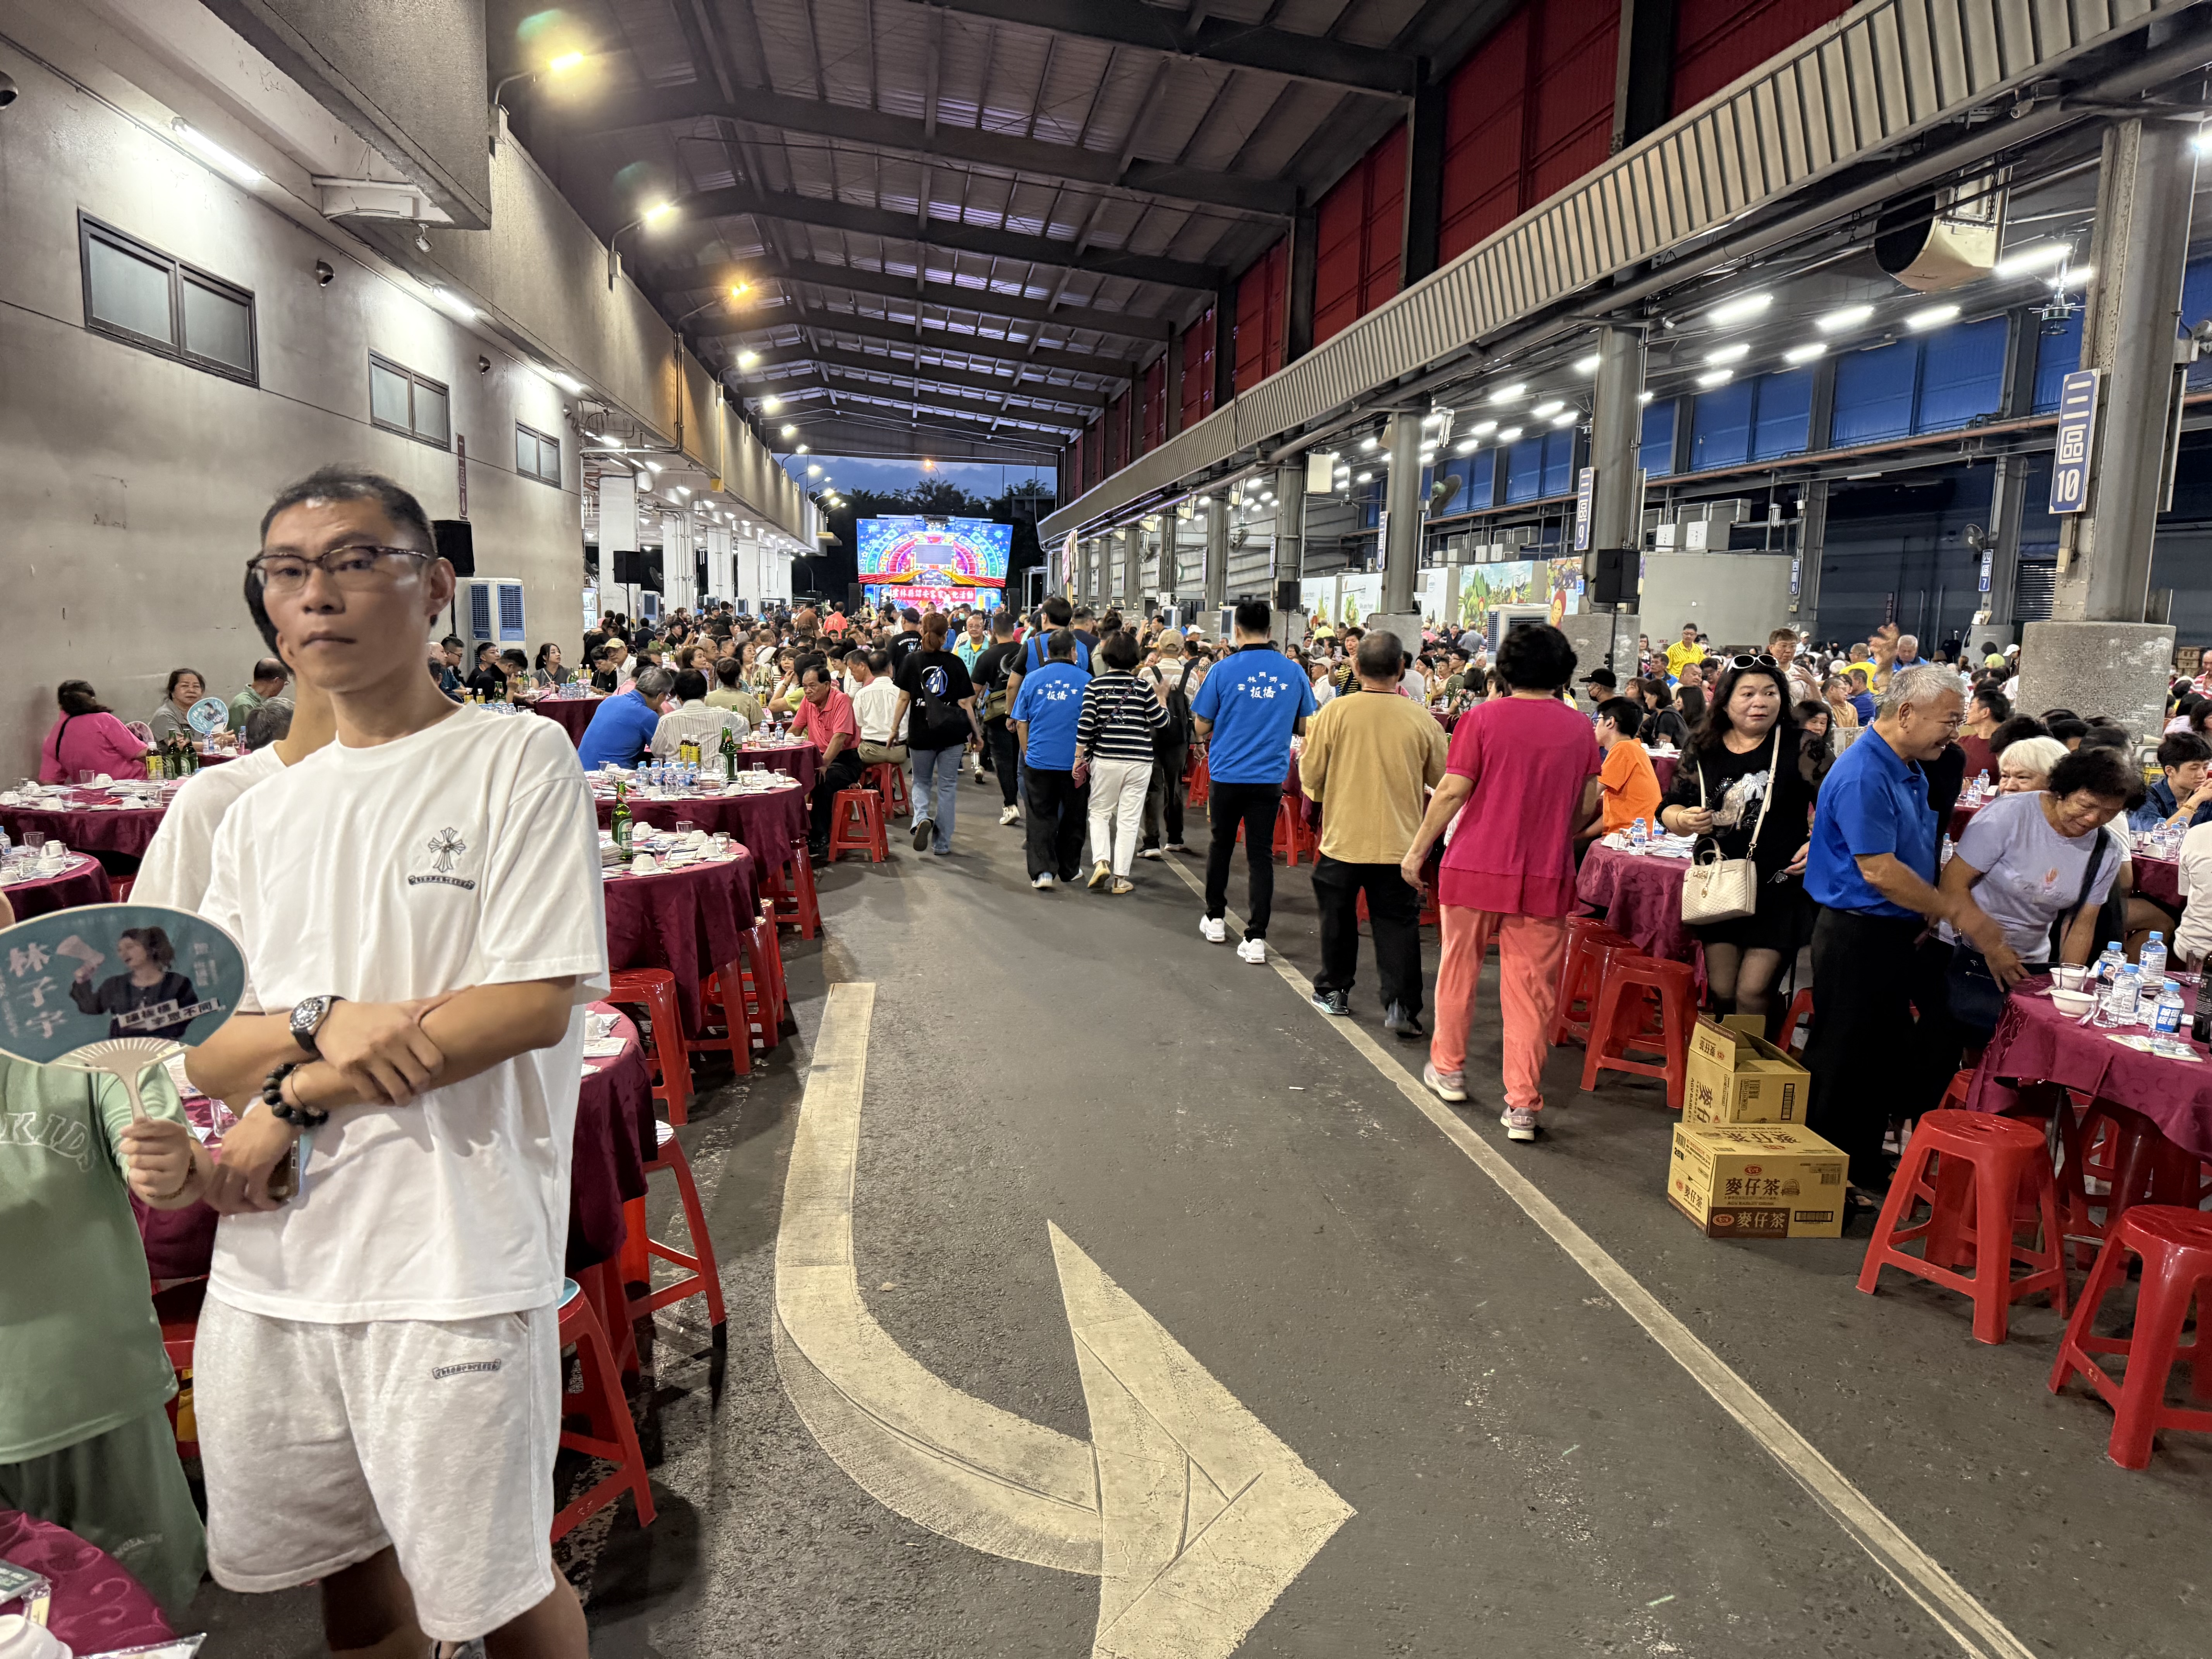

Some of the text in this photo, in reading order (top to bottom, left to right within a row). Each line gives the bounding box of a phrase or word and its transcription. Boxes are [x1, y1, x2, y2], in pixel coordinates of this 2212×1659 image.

[892, 588, 974, 600] 雲林縣詔安客家化活動
[1047, 690, 1068, 701] 板橋
[1250, 686, 1276, 699] 板橋
[1724, 1177, 1781, 1196] 麥仔茶
[1736, 1211, 1786, 1228] 麥仔茶
